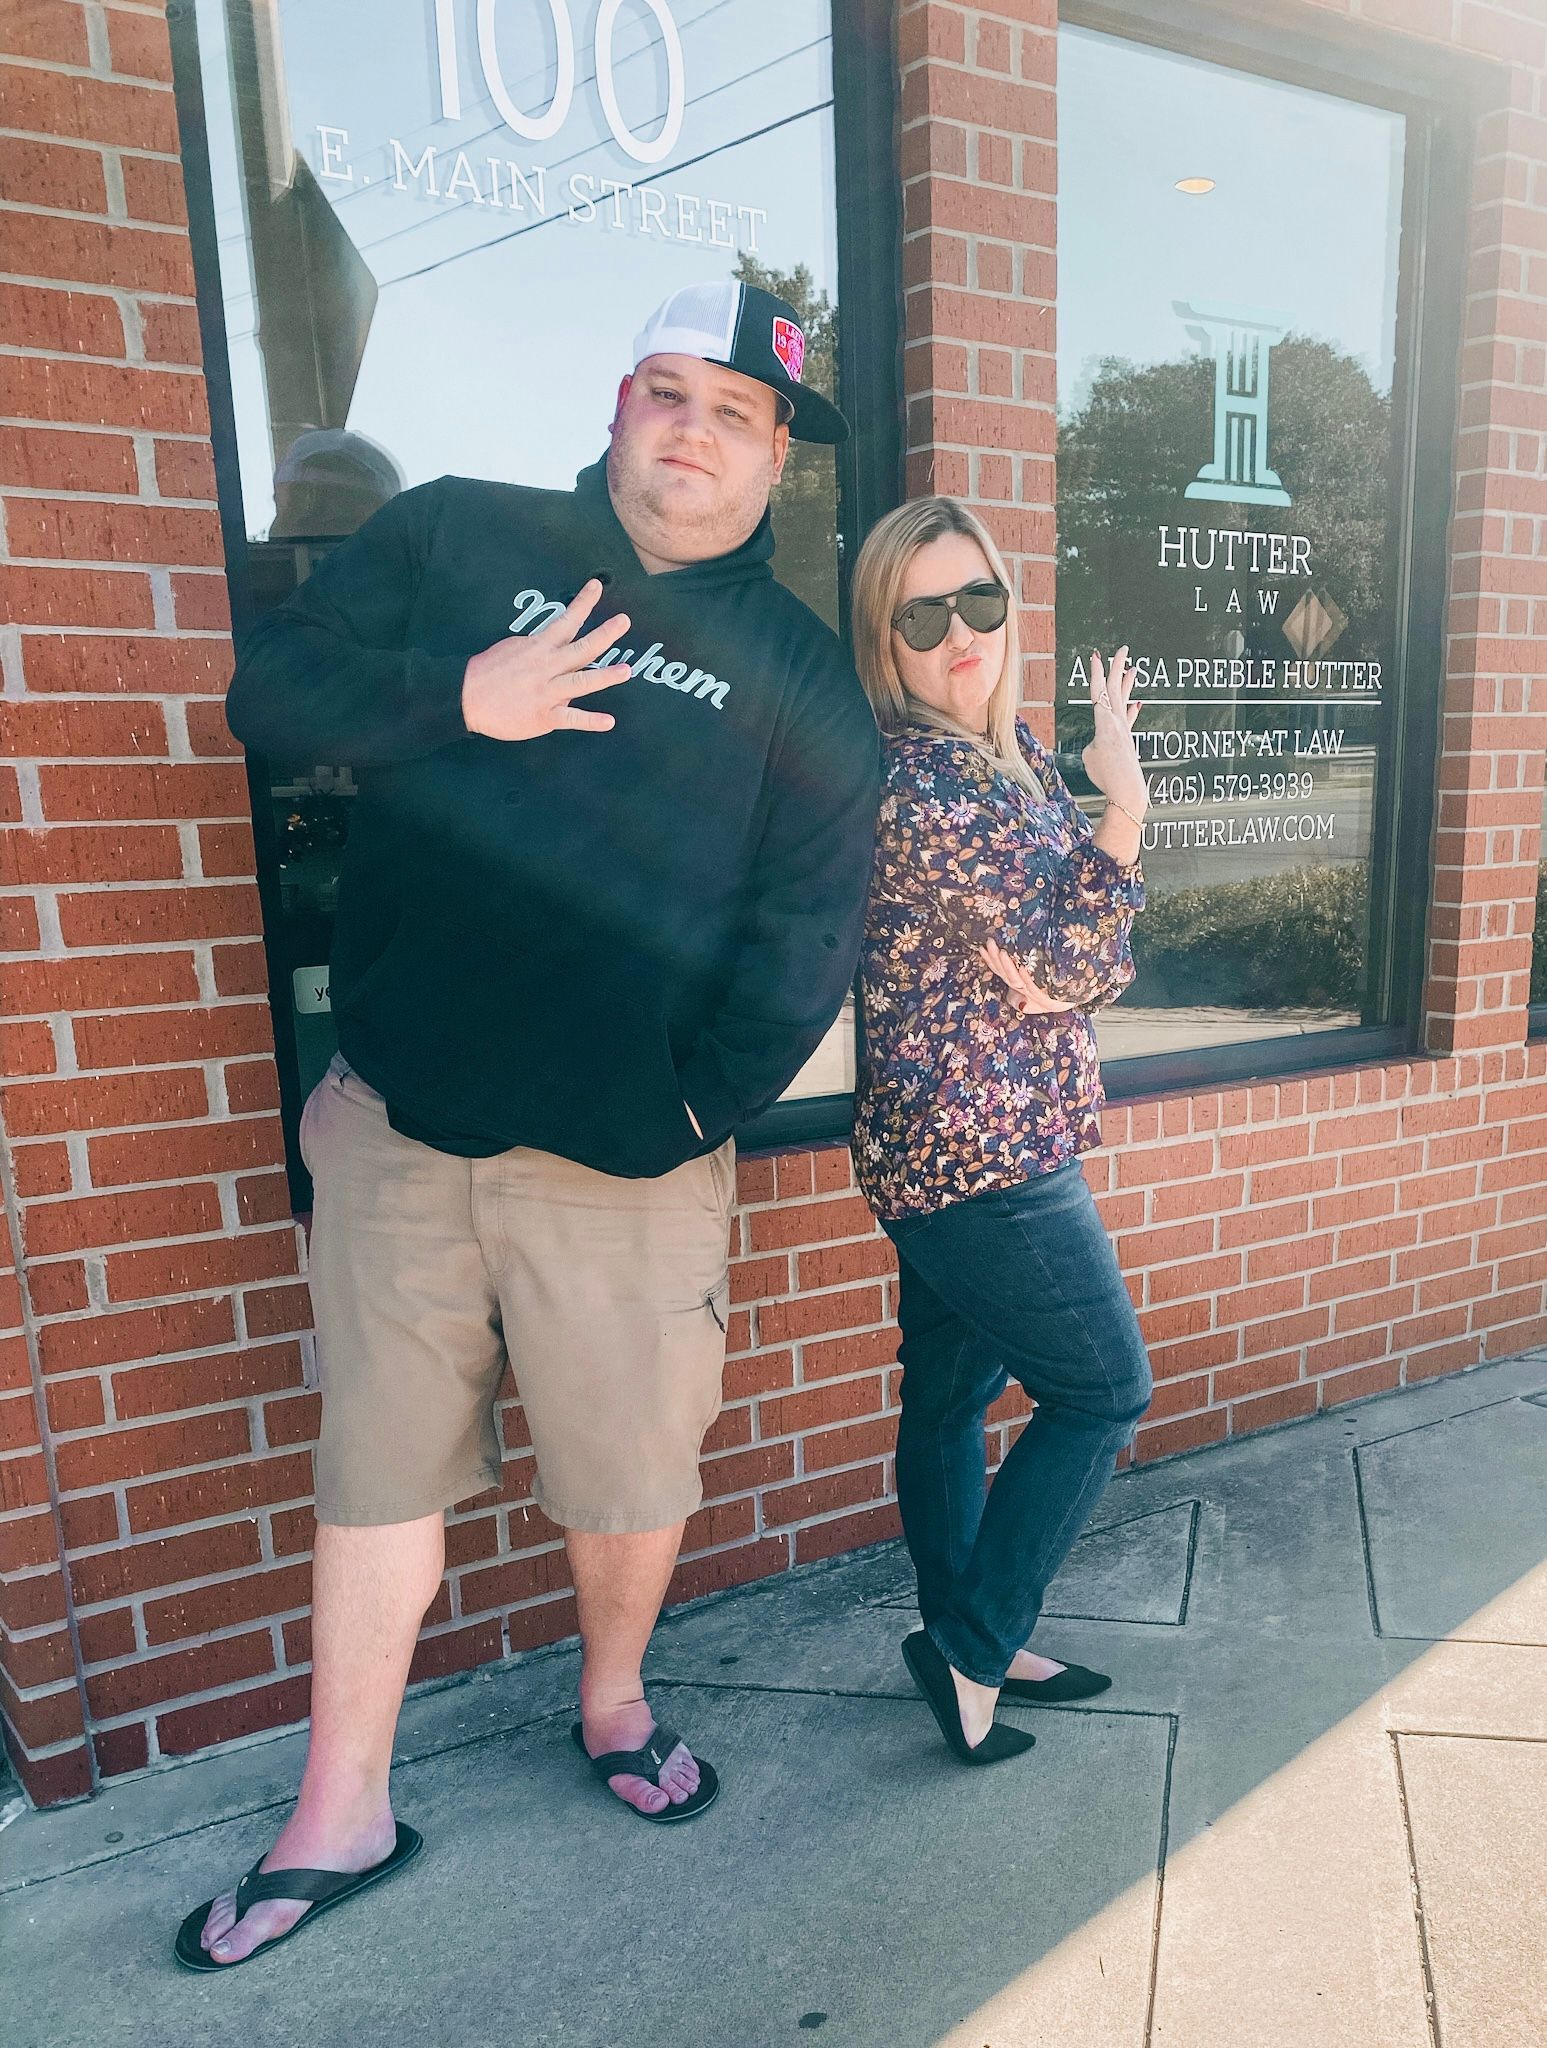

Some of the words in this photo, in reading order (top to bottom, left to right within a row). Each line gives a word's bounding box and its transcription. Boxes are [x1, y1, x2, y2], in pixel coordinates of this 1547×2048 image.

[435, 0, 685, 164] 100
[315, 124, 371, 184] E.
[389, 138, 547, 216] MAIN
[567, 174, 767, 252] STREET
[1158, 525, 1313, 576] HUTTER
[1177, 658, 1276, 689] PREBLE
[1283, 660, 1383, 690] HUTTER
[1131, 730, 1252, 760] TTORNEY
[1256, 729, 1288, 757] AT
[1293, 728, 1344, 756] LAW
[1146, 772, 1206, 808] (405)
[1212, 772, 1314, 803] 579-3939
[1141, 813, 1335, 850] UTTERLAW.COM
